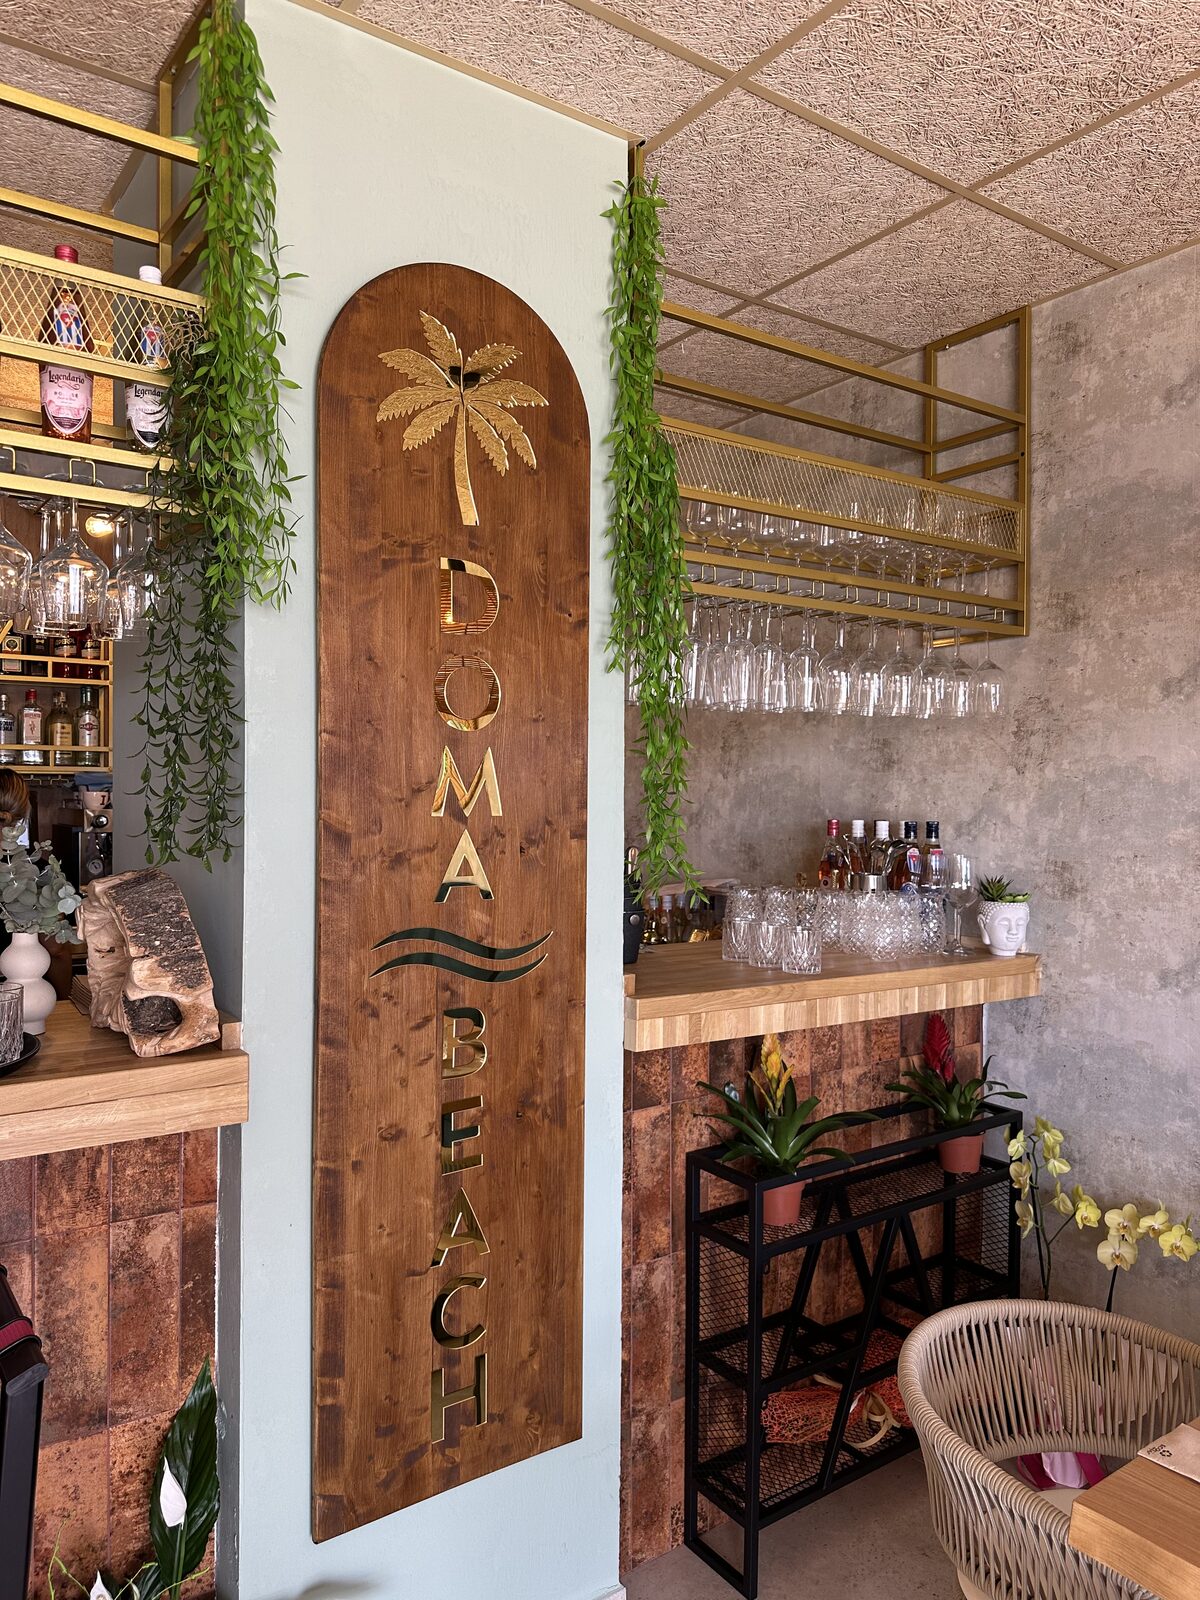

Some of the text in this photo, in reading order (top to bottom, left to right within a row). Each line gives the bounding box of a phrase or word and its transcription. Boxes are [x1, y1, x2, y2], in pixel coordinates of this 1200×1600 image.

[48, 370, 85, 384] Legendario
[134, 384, 164, 399] Legendar
[431, 556, 503, 903] DOMA
[430, 1007, 491, 1444] BEACH
